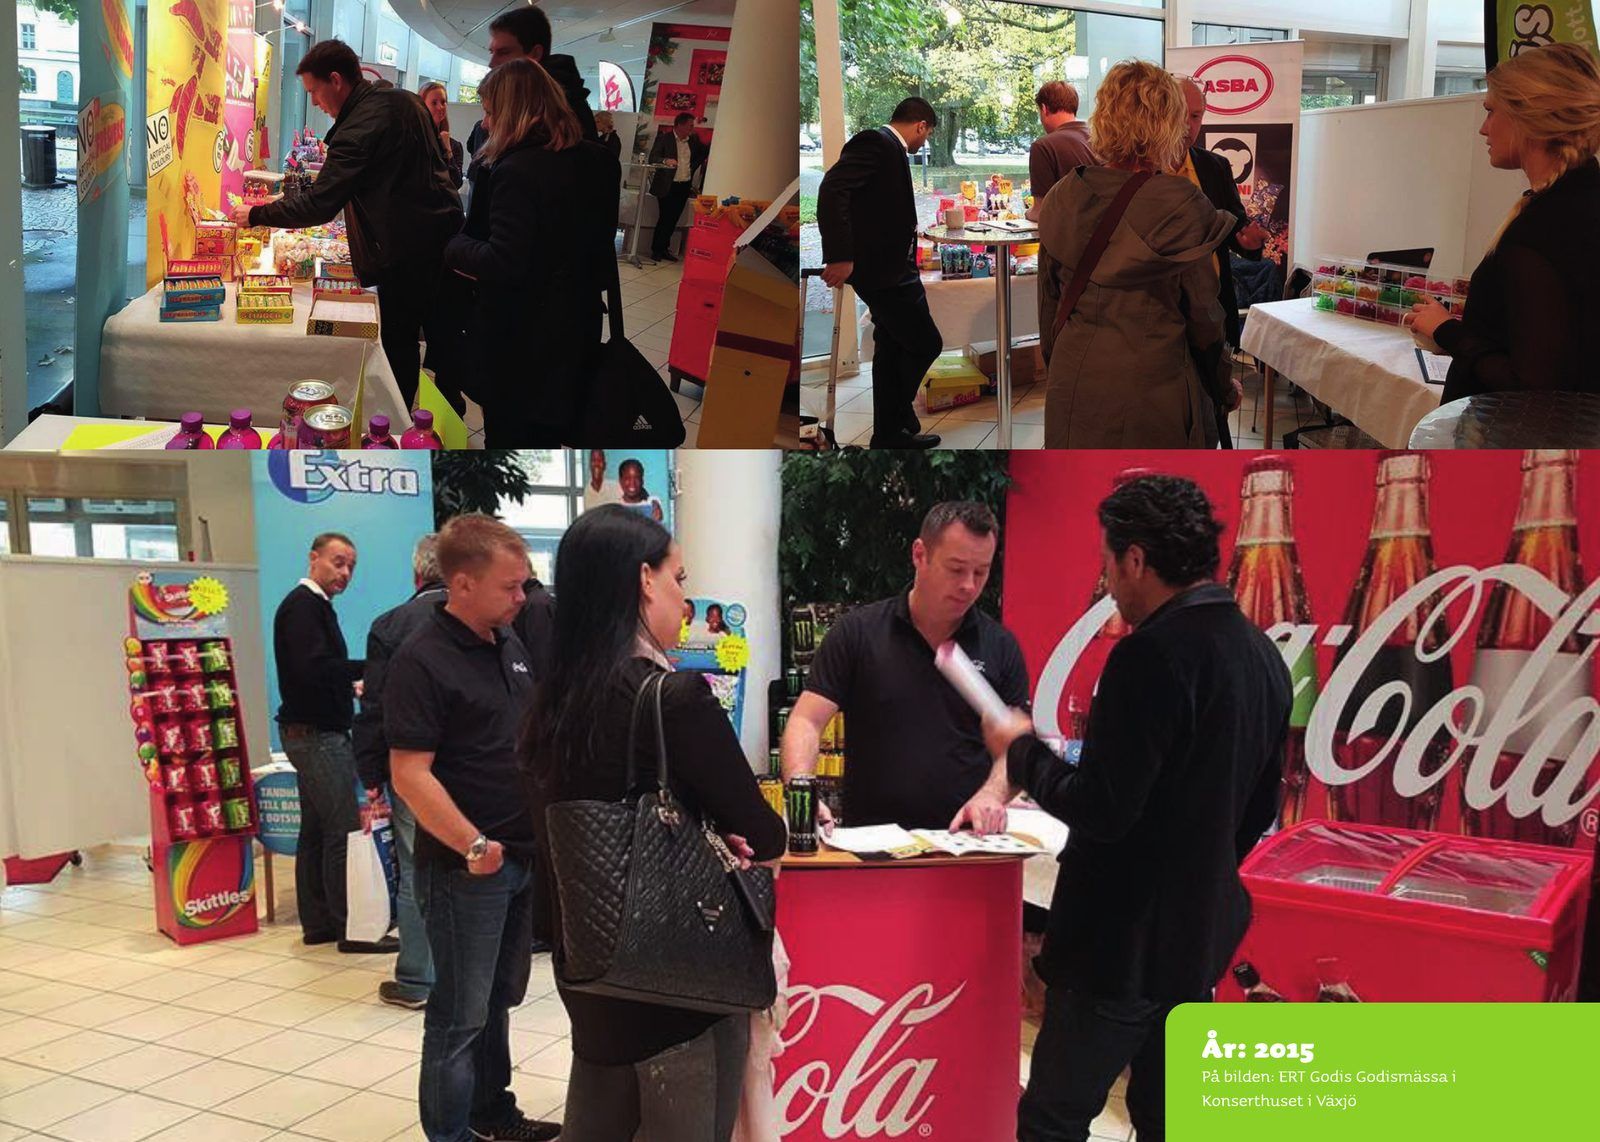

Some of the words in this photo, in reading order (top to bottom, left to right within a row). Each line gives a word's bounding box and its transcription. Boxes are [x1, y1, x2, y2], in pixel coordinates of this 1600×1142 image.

[1202, 78, 1259, 93] ASBA
[290, 450, 419, 496] Extra
[185, 890, 250, 917] Skittles
